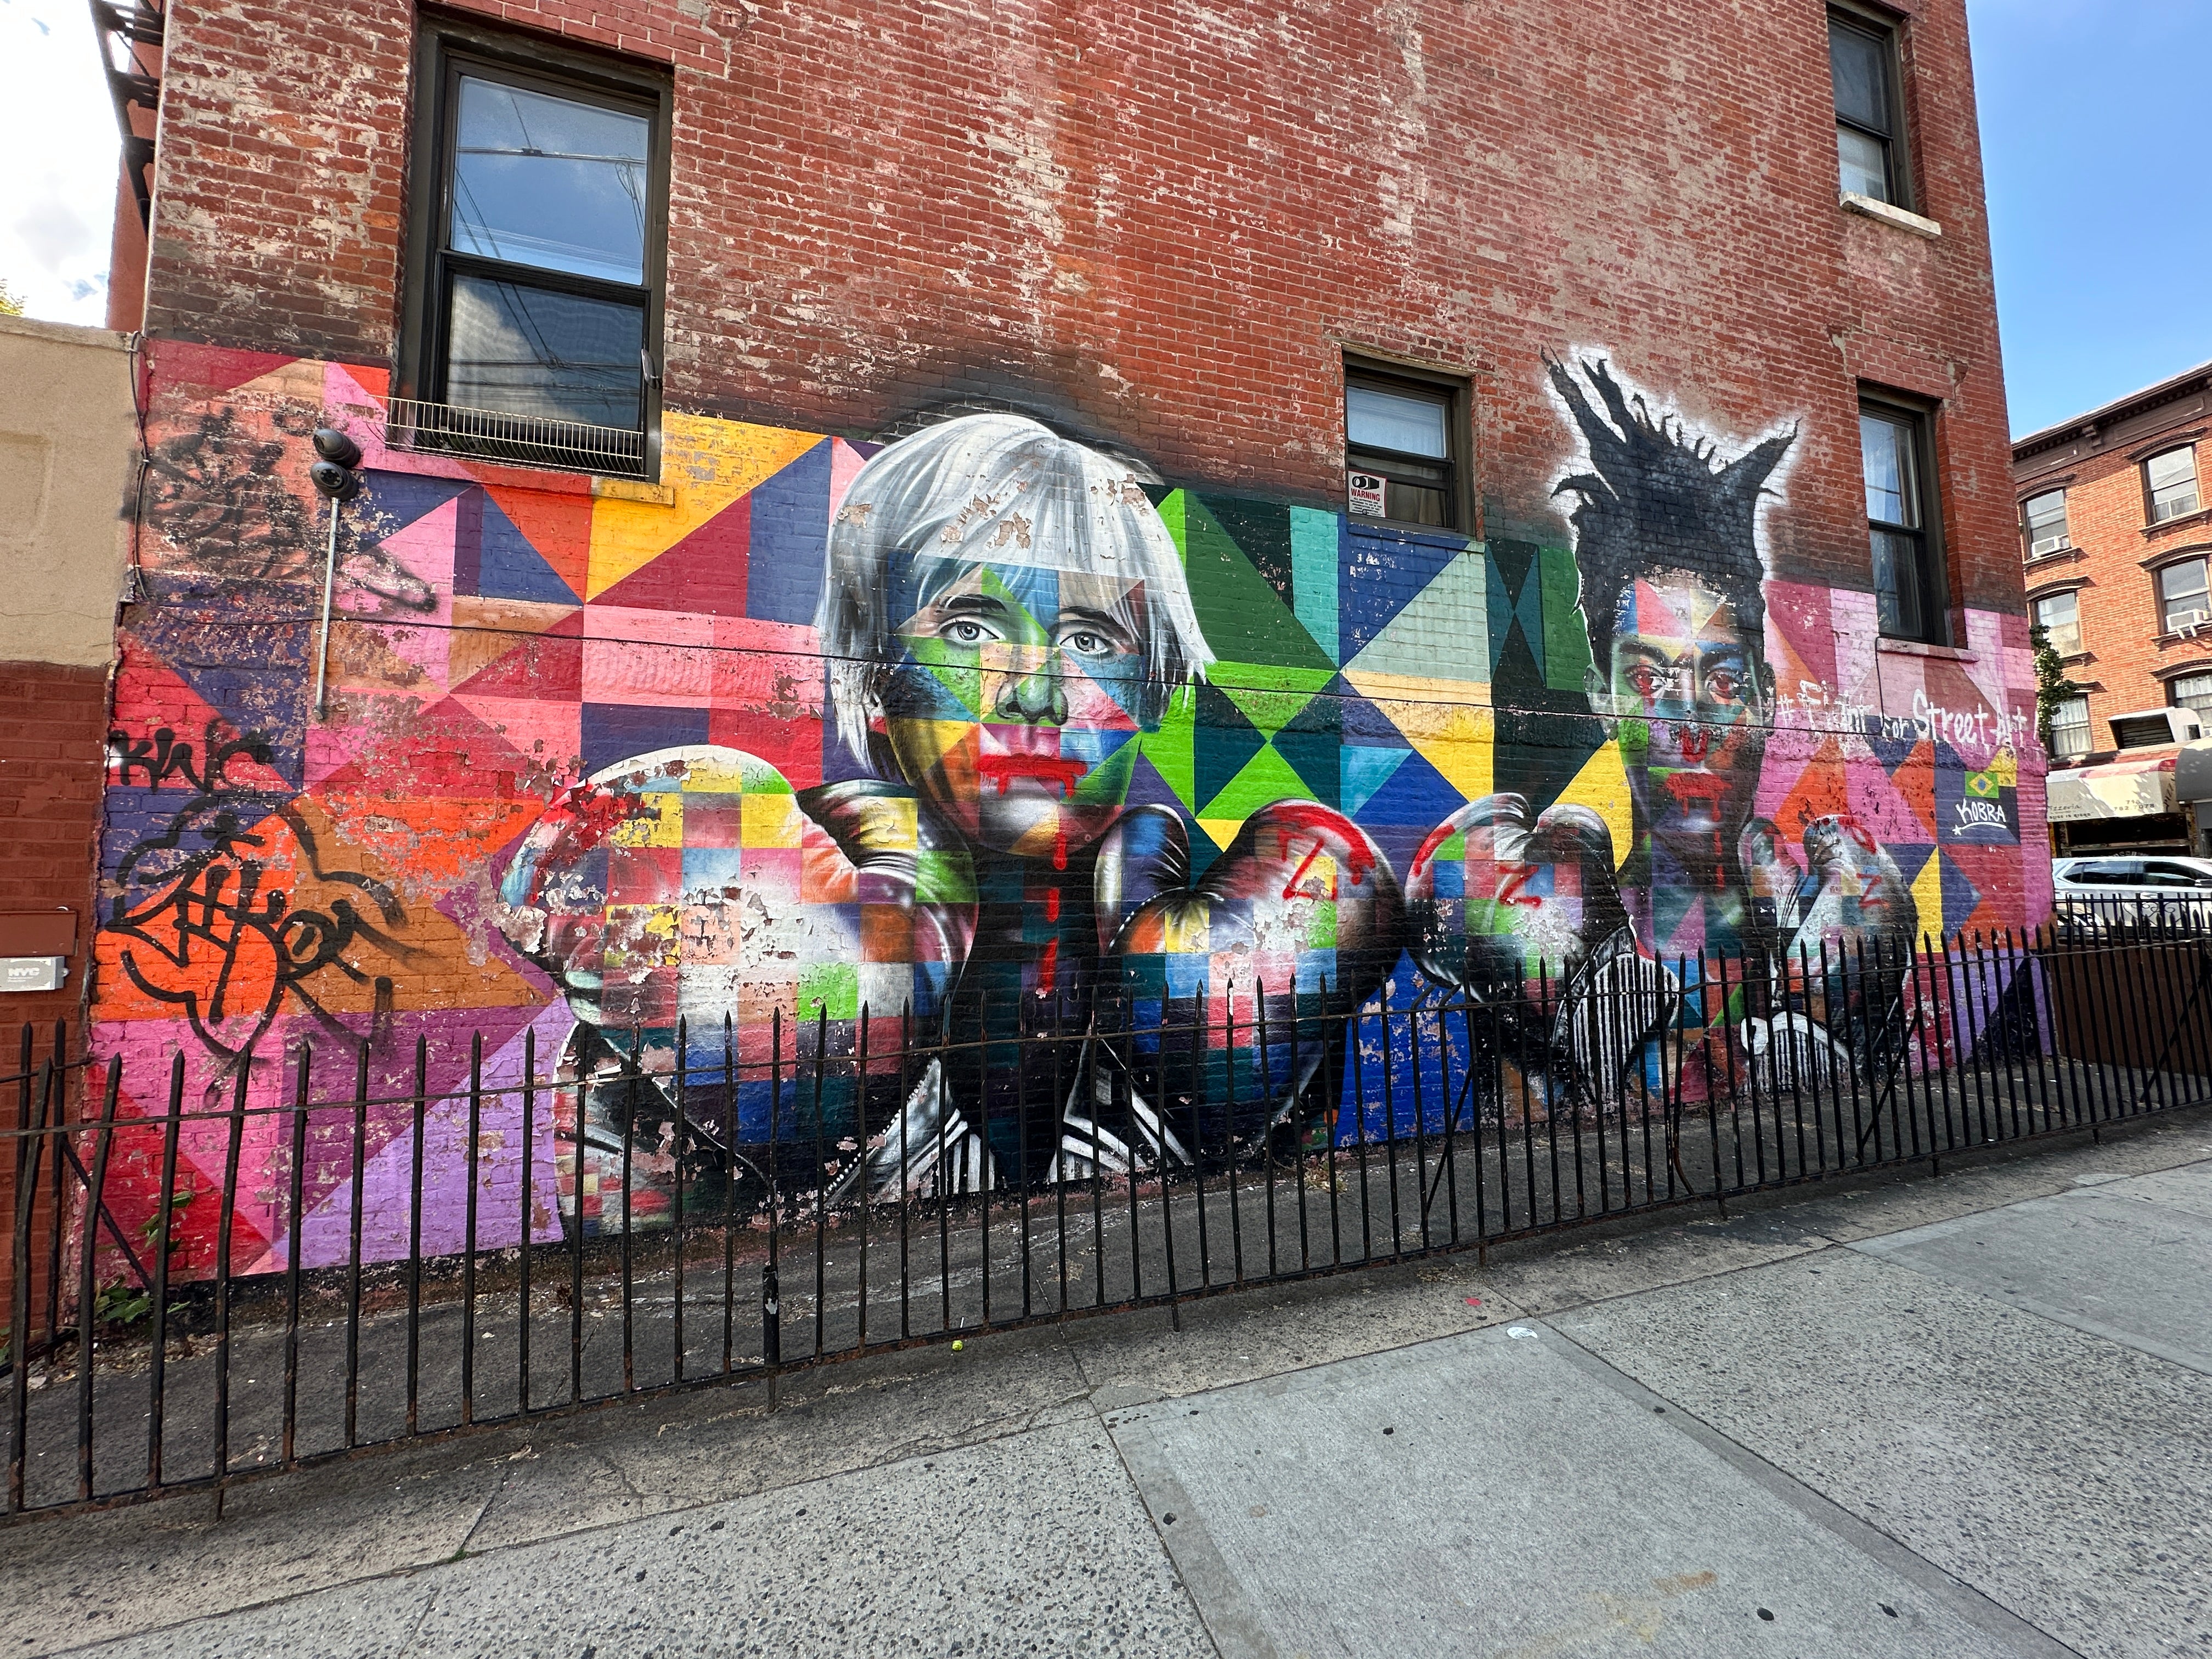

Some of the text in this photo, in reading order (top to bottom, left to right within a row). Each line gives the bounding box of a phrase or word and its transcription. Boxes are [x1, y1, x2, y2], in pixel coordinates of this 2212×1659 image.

[1351, 488, 1380, 501] WARNING
[1913, 689, 1989, 749] Street
[1956, 799, 2006, 823] KOBRA
